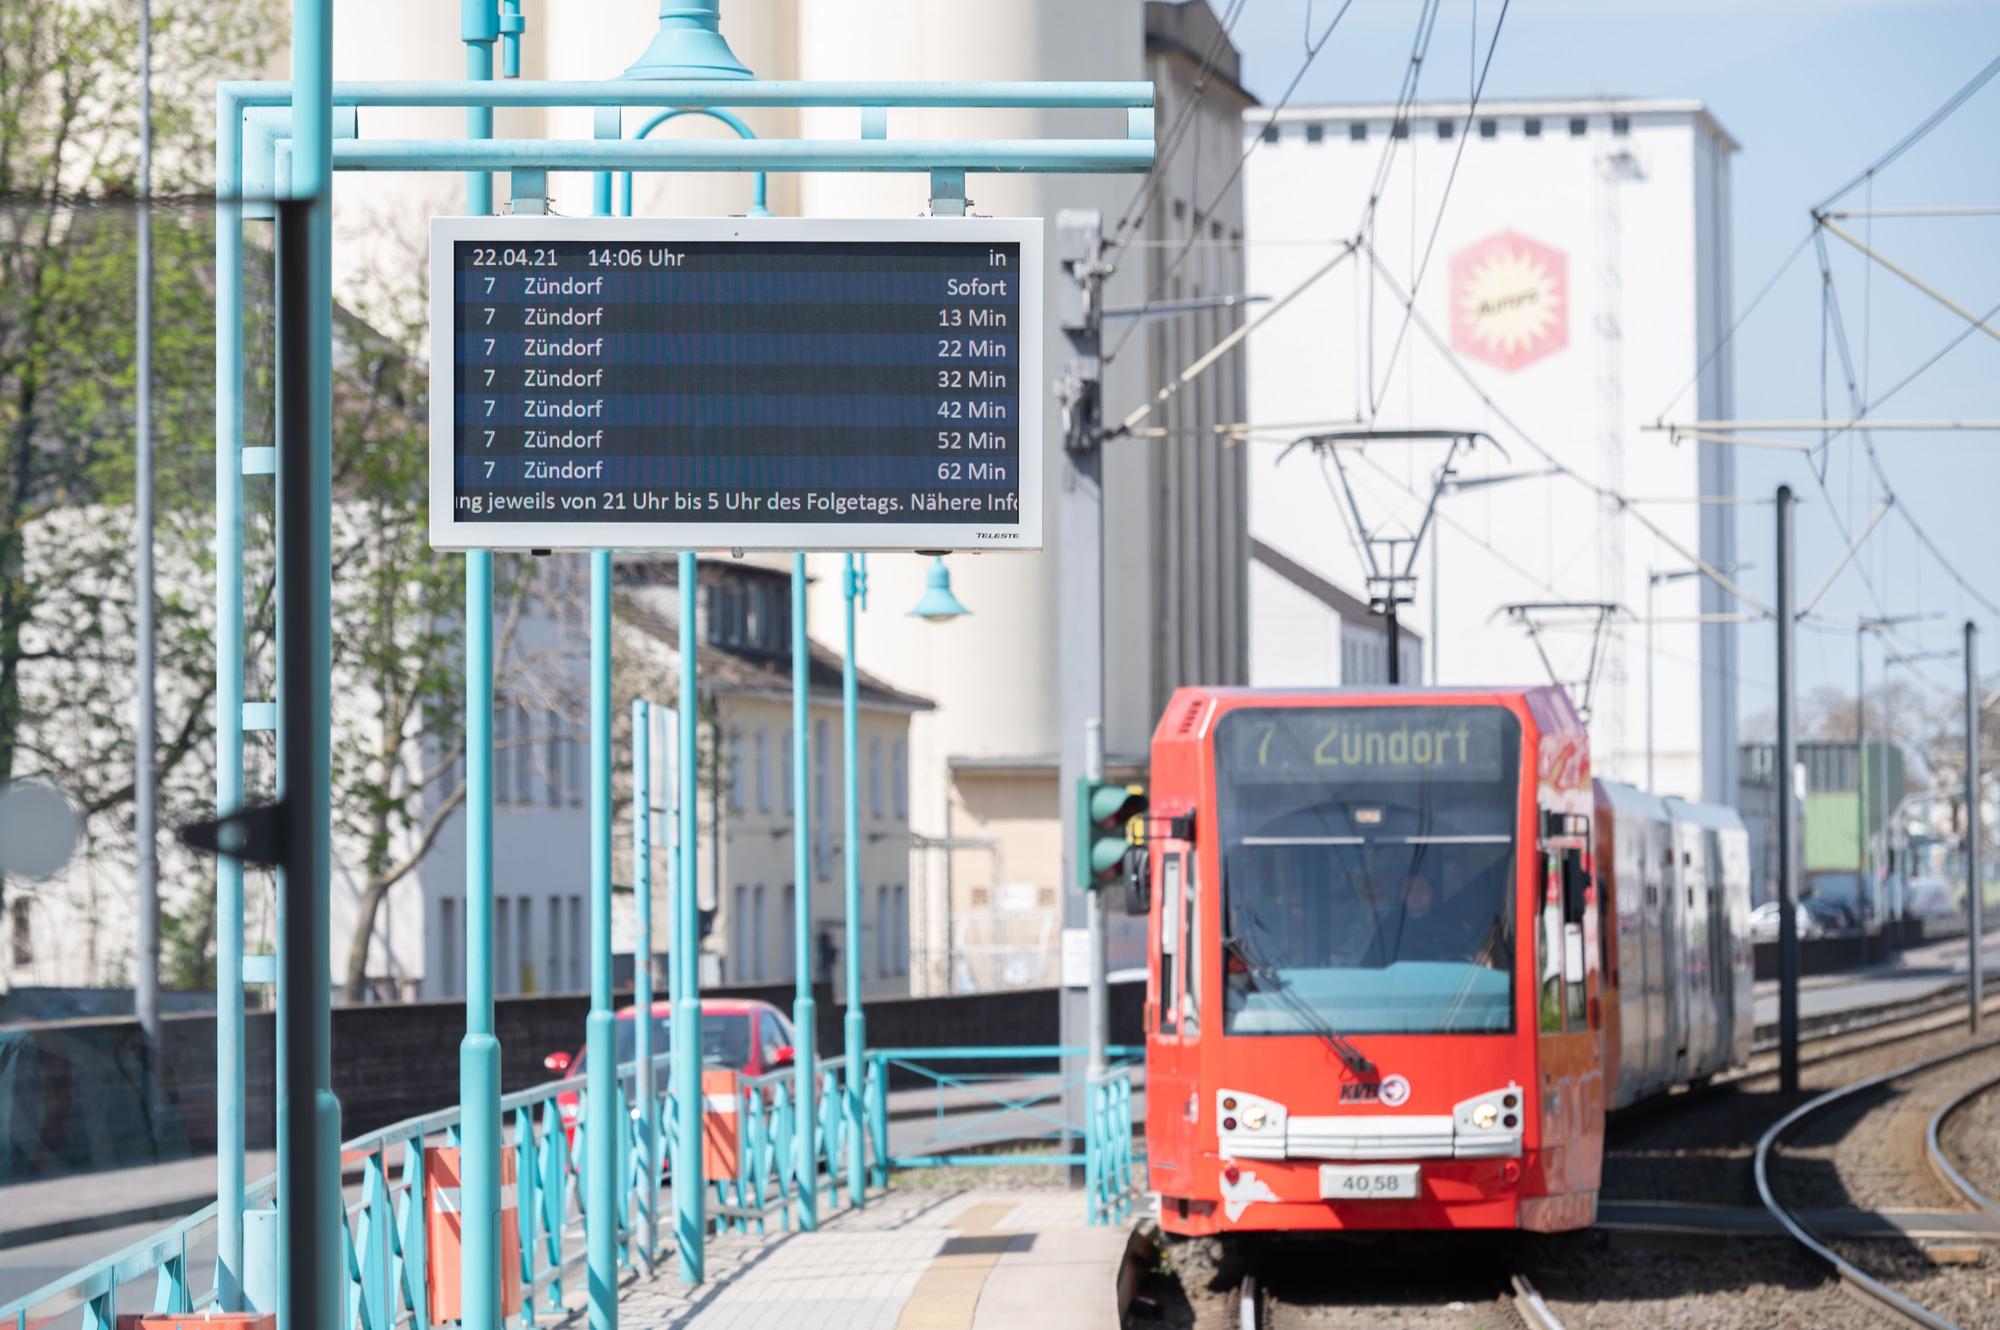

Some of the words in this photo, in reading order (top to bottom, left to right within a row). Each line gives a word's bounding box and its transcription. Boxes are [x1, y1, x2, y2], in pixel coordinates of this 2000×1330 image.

[473, 248, 558, 266] 22.04.21
[588, 249, 642, 267] 14:06
[649, 248, 685, 267] Uhr
[989, 248, 1007, 267] in
[484, 277, 496, 294] 7
[524, 276, 603, 295] Zündorf
[947, 277, 1007, 296] Sofort
[484, 307, 496, 325] 7
[524, 307, 604, 326] Zündorf
[938, 309, 962, 327] 13
[968, 309, 1007, 327] Min
[484, 338, 496, 356] 7
[524, 338, 604, 357] Zündorf
[938, 340, 962, 358] 22
[968, 340, 1007, 358] Min
[484, 368, 496, 386] 7
[524, 368, 604, 387] Zündorf
[938, 370, 962, 388] 32
[968, 370, 1007, 388] Min
[484, 399, 496, 417] 7
[524, 399, 604, 418] Zündorf
[938, 401, 962, 419] 42
[968, 401, 1007, 419] Min
[484, 430, 496, 448] 7
[524, 430, 604, 449] Zündorf
[938, 432, 962, 450] 52
[968, 432, 1007, 450] Min
[484, 460, 496, 478] 7
[524, 460, 604, 479] Zündorf
[938, 462, 962, 480] 62
[968, 462, 1007, 480] Min
[455, 496, 483, 514] ng
[486, 491, 556, 514] jeweils
[561, 496, 597, 510] von
[603, 492, 627, 510] 21
[633, 491, 669, 510] Uhr
[675, 491, 702, 510] bis
[708, 492, 719, 510] 5
[726, 491, 762, 510] Uhr
[767, 491, 801, 511] des
[807, 491, 904, 515] Folgetags.
[911, 492, 982, 511] Nähere
[1256, 721, 1276, 767] 7
